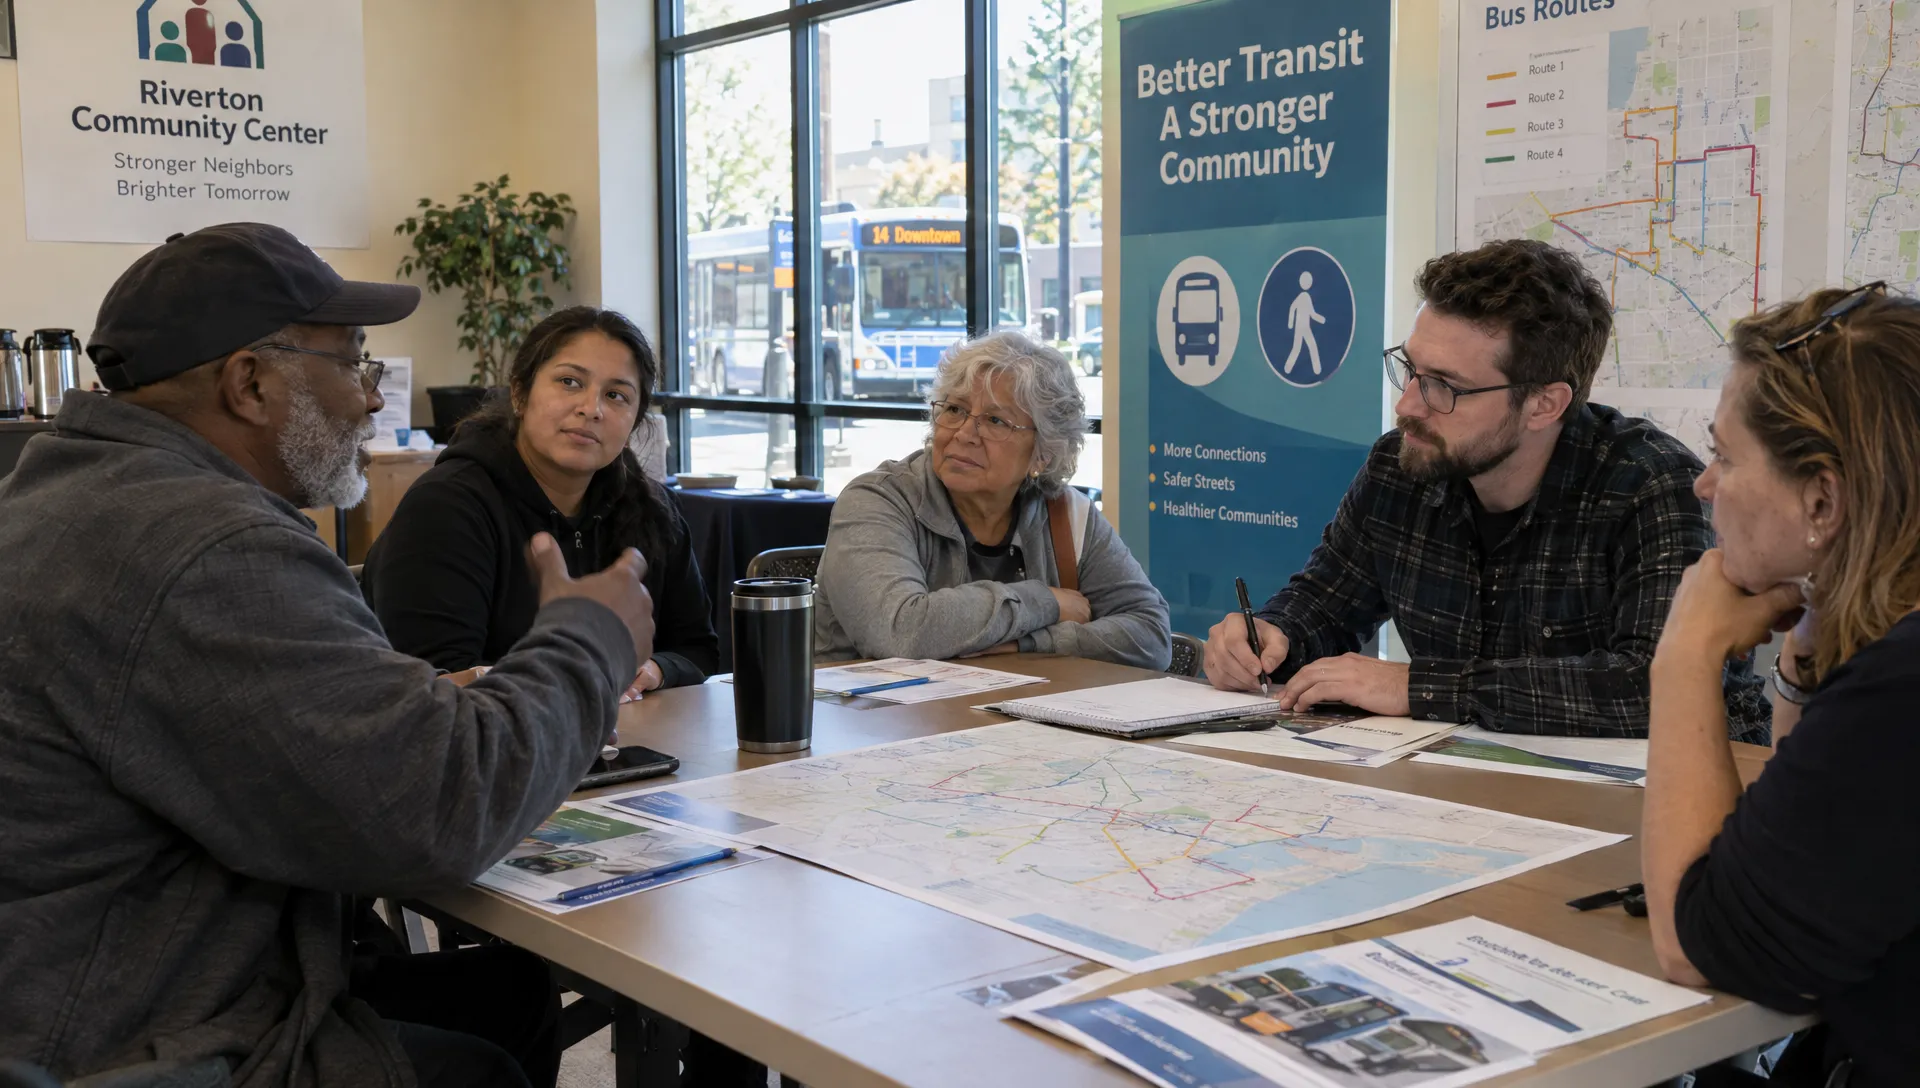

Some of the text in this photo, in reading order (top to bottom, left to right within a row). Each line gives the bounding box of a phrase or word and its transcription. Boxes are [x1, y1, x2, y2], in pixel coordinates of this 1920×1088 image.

[1485, 6, 1526, 30] Bus
[1138, 27, 1364, 98] Better Transit
[1529, 64, 1555, 75] Route
[141, 80, 263, 111] Riverton
[1529, 90, 1564, 103] Route 2
[71, 106, 328, 145] Community Center
[1160, 91, 1334, 140] A Stronger
[1528, 119, 1563, 132] Route 3
[115, 152, 293, 178] Stronger Neighbors
[1160, 135, 1335, 185] Community
[1527, 148, 1563, 160] Route 4
[118, 180, 290, 201] Brighter Tomorrow
[873, 226, 961, 244] 14 Downtown
[1164, 443, 1266, 463] More Connections
[1164, 471, 1235, 491] Safer Streets
[1164, 501, 1299, 529] Healthier Communities
